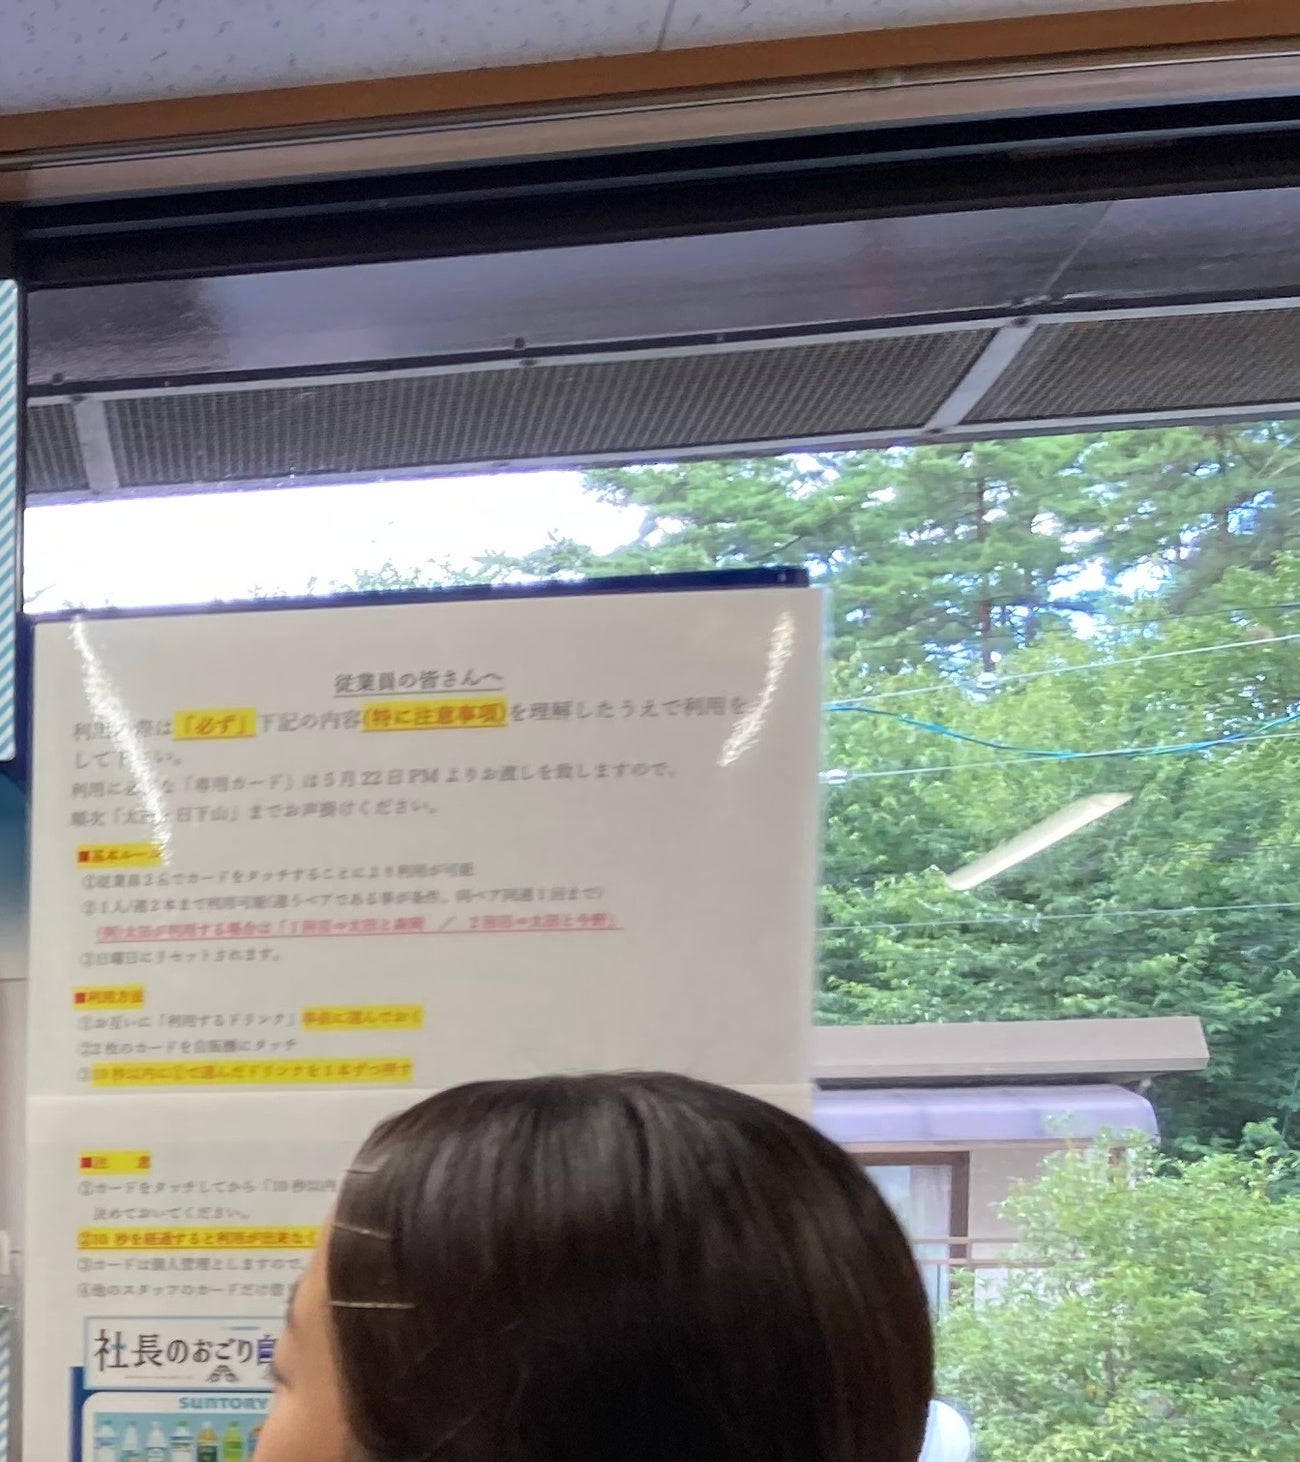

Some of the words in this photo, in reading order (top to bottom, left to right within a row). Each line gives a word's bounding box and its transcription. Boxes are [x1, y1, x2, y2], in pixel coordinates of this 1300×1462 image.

[334, 668, 503, 693] 従業員の皆さんへ
[179, 1397, 268, 1410] SUNTORY
